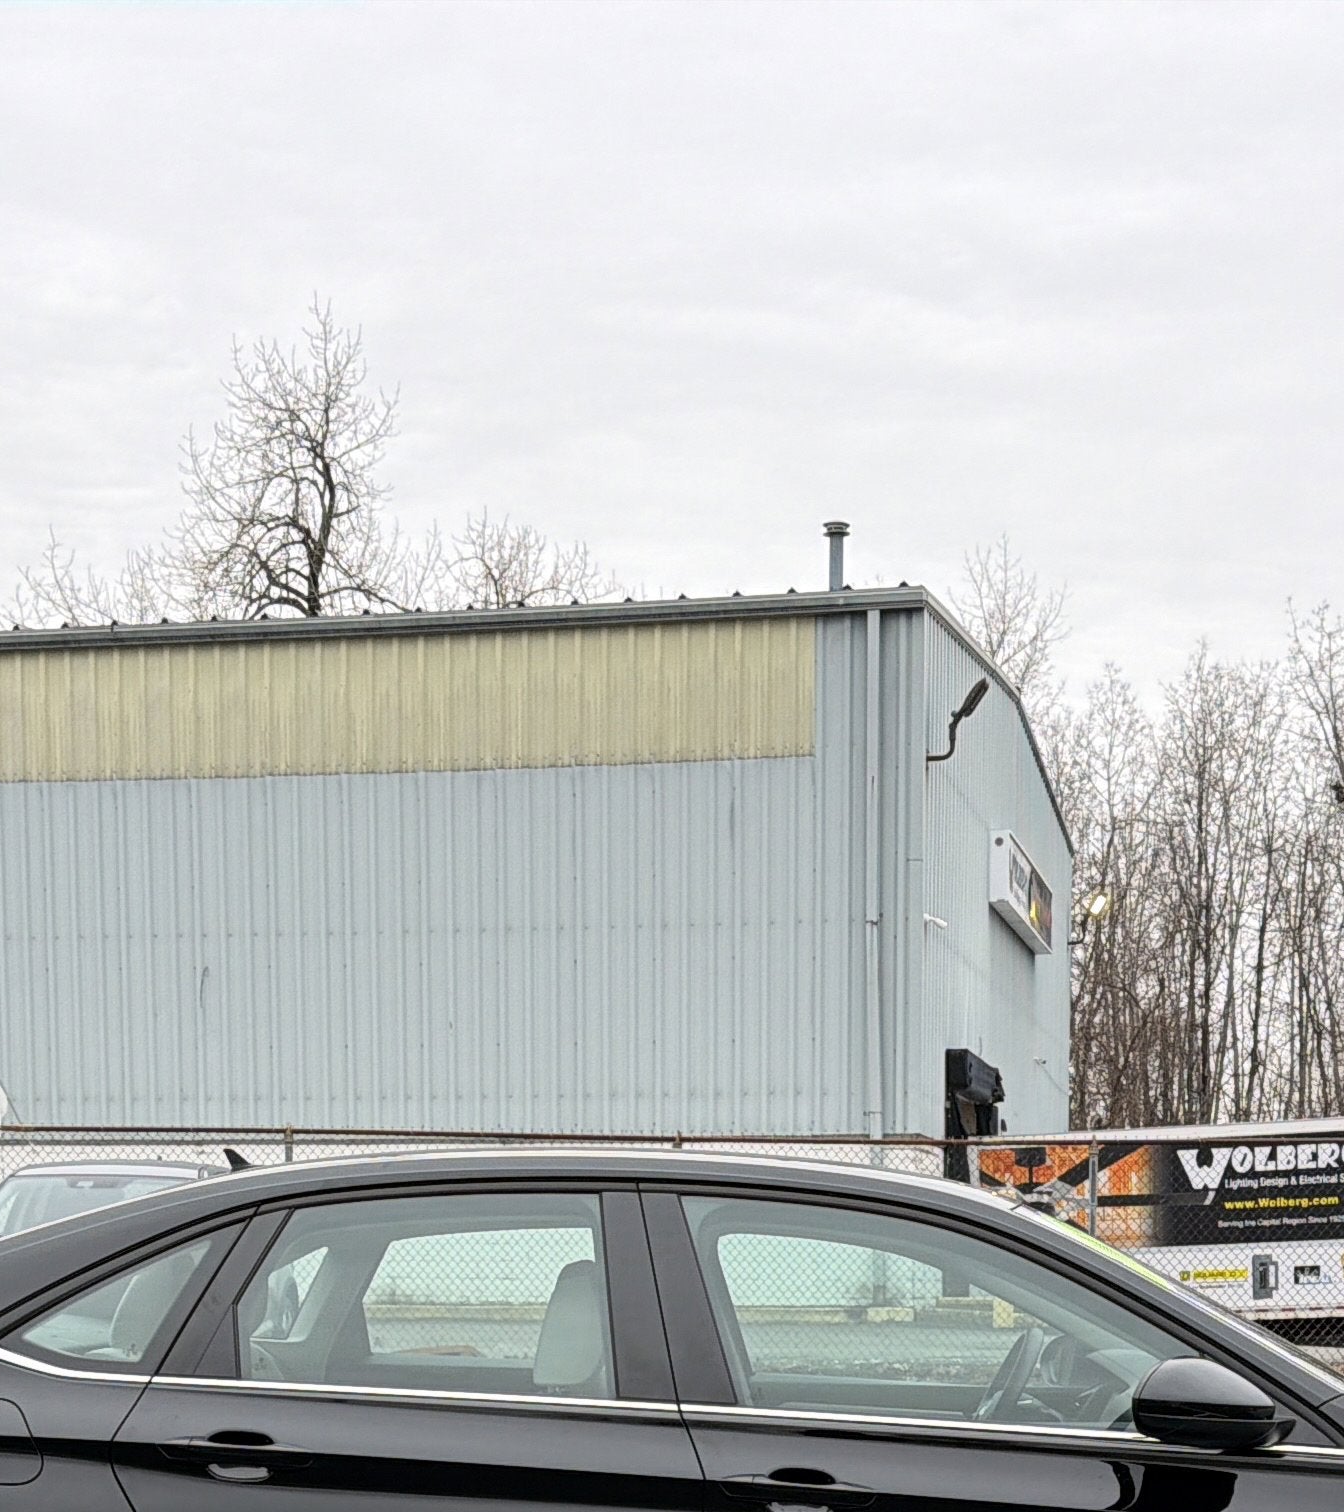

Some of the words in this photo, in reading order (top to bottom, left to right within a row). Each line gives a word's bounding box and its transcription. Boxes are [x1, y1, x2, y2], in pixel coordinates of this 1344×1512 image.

[1225, 1178, 1258, 1190] Lighting
[1260, 1176, 1289, 1188] Design
[1299, 1172, 1338, 1185] Electrical
[1224, 1196, 1339, 1209] www.Wolberg.com
